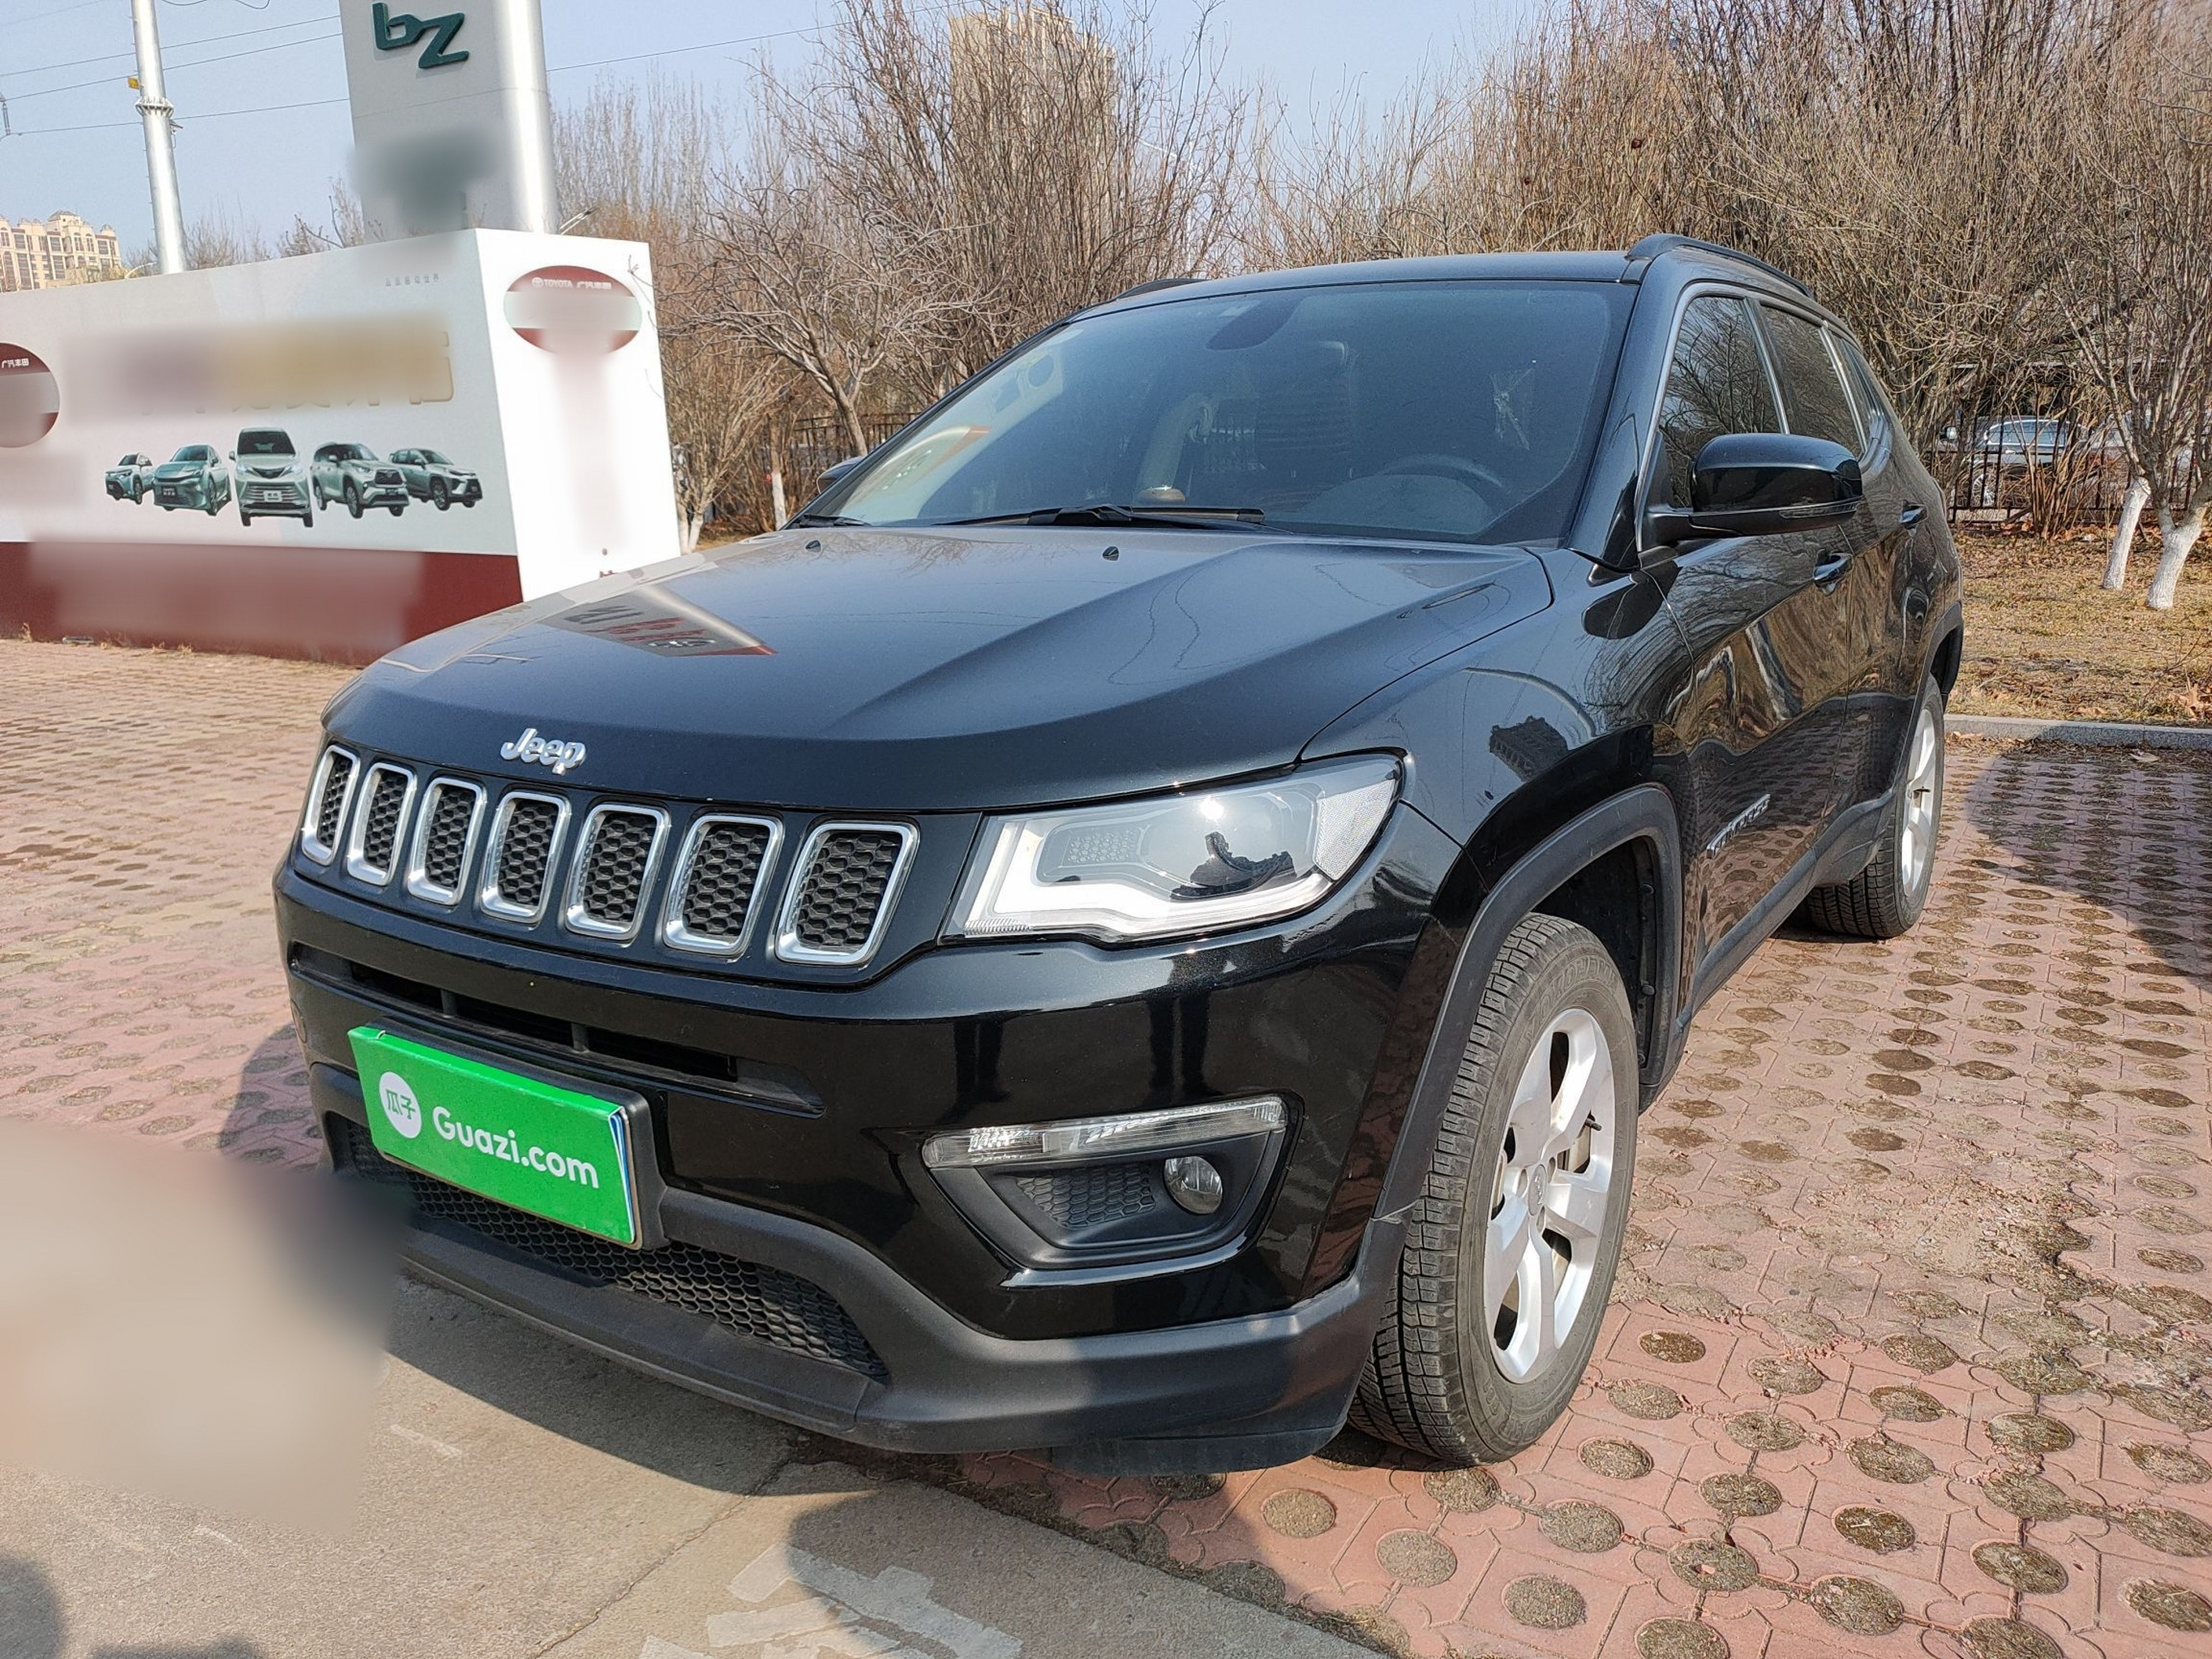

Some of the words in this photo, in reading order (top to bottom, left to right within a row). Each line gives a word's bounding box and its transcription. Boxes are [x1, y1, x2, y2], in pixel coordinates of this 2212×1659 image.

[543, 279, 574, 288] TOYOTA
[500, 728, 586, 775] Jeep
[386, 1088, 416, 1120] 瓜子
[433, 1106, 599, 1188] Guazi.com
